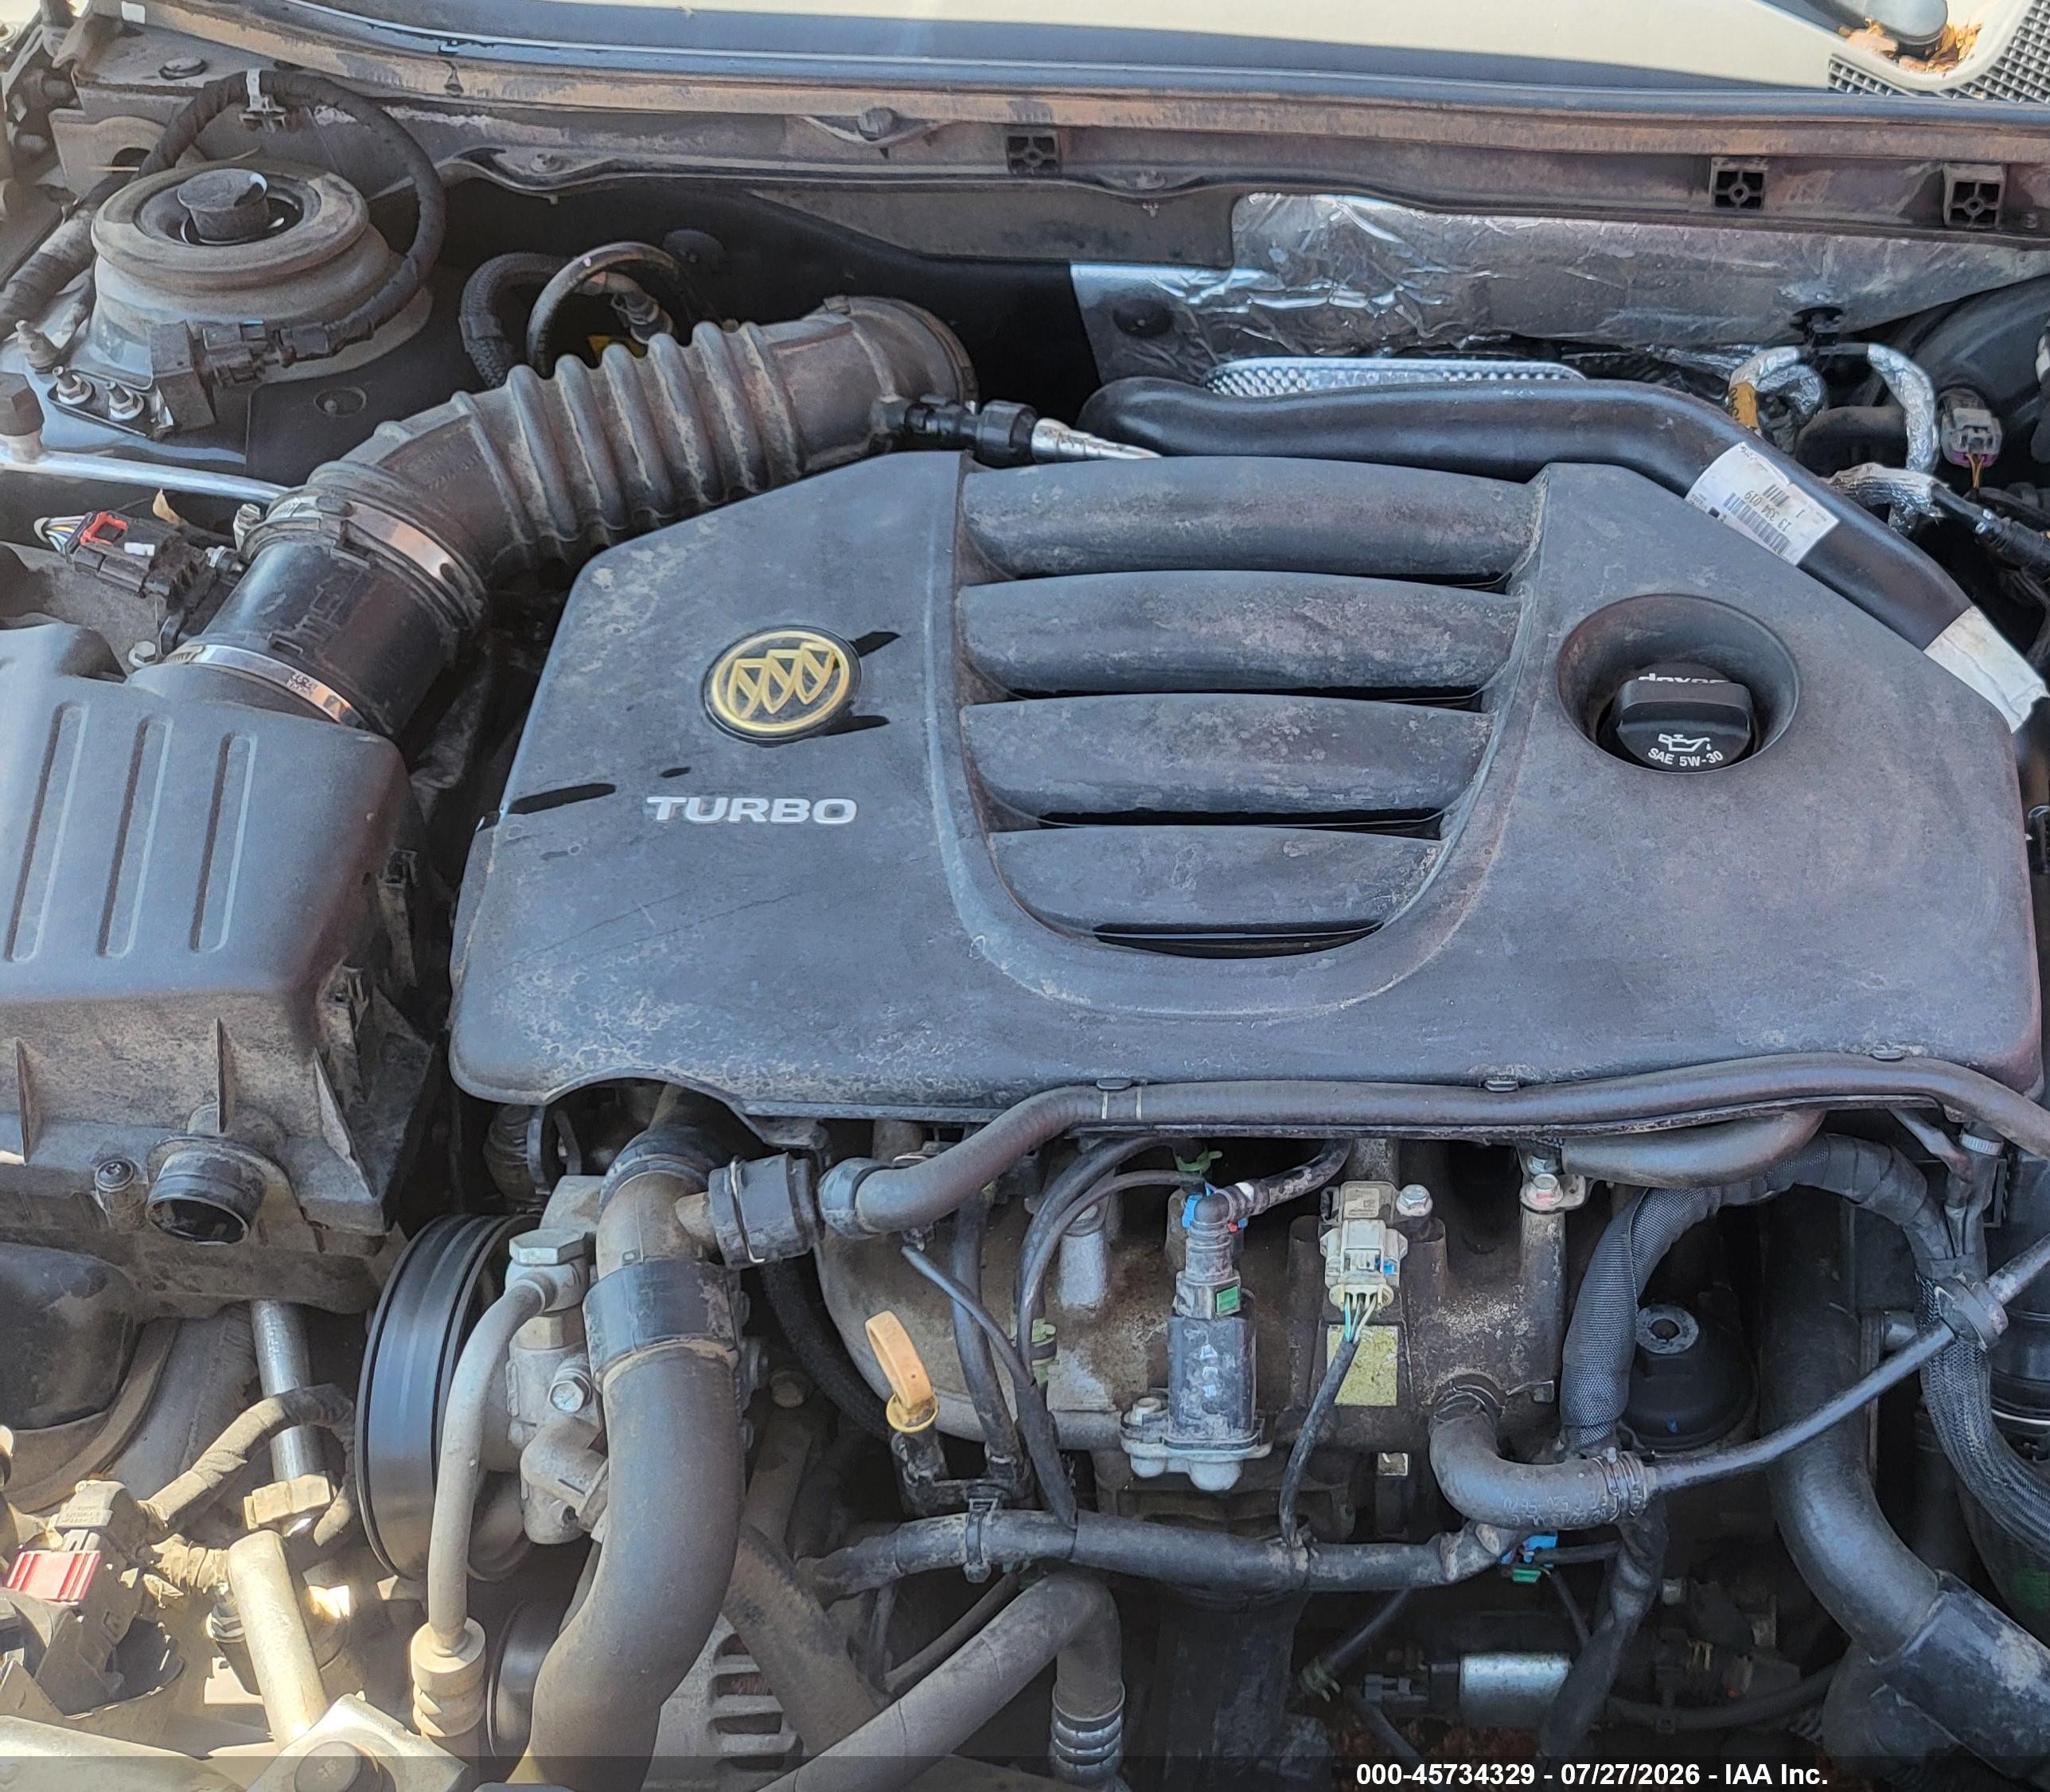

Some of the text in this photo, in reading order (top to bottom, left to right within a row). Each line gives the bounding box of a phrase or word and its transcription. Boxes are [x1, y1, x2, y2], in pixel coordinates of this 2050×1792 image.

[1744, 490, 1792, 532] 13 334 019
[1647, 747, 1724, 767] SAE 5W-30
[646, 796, 858, 825] TURBO
